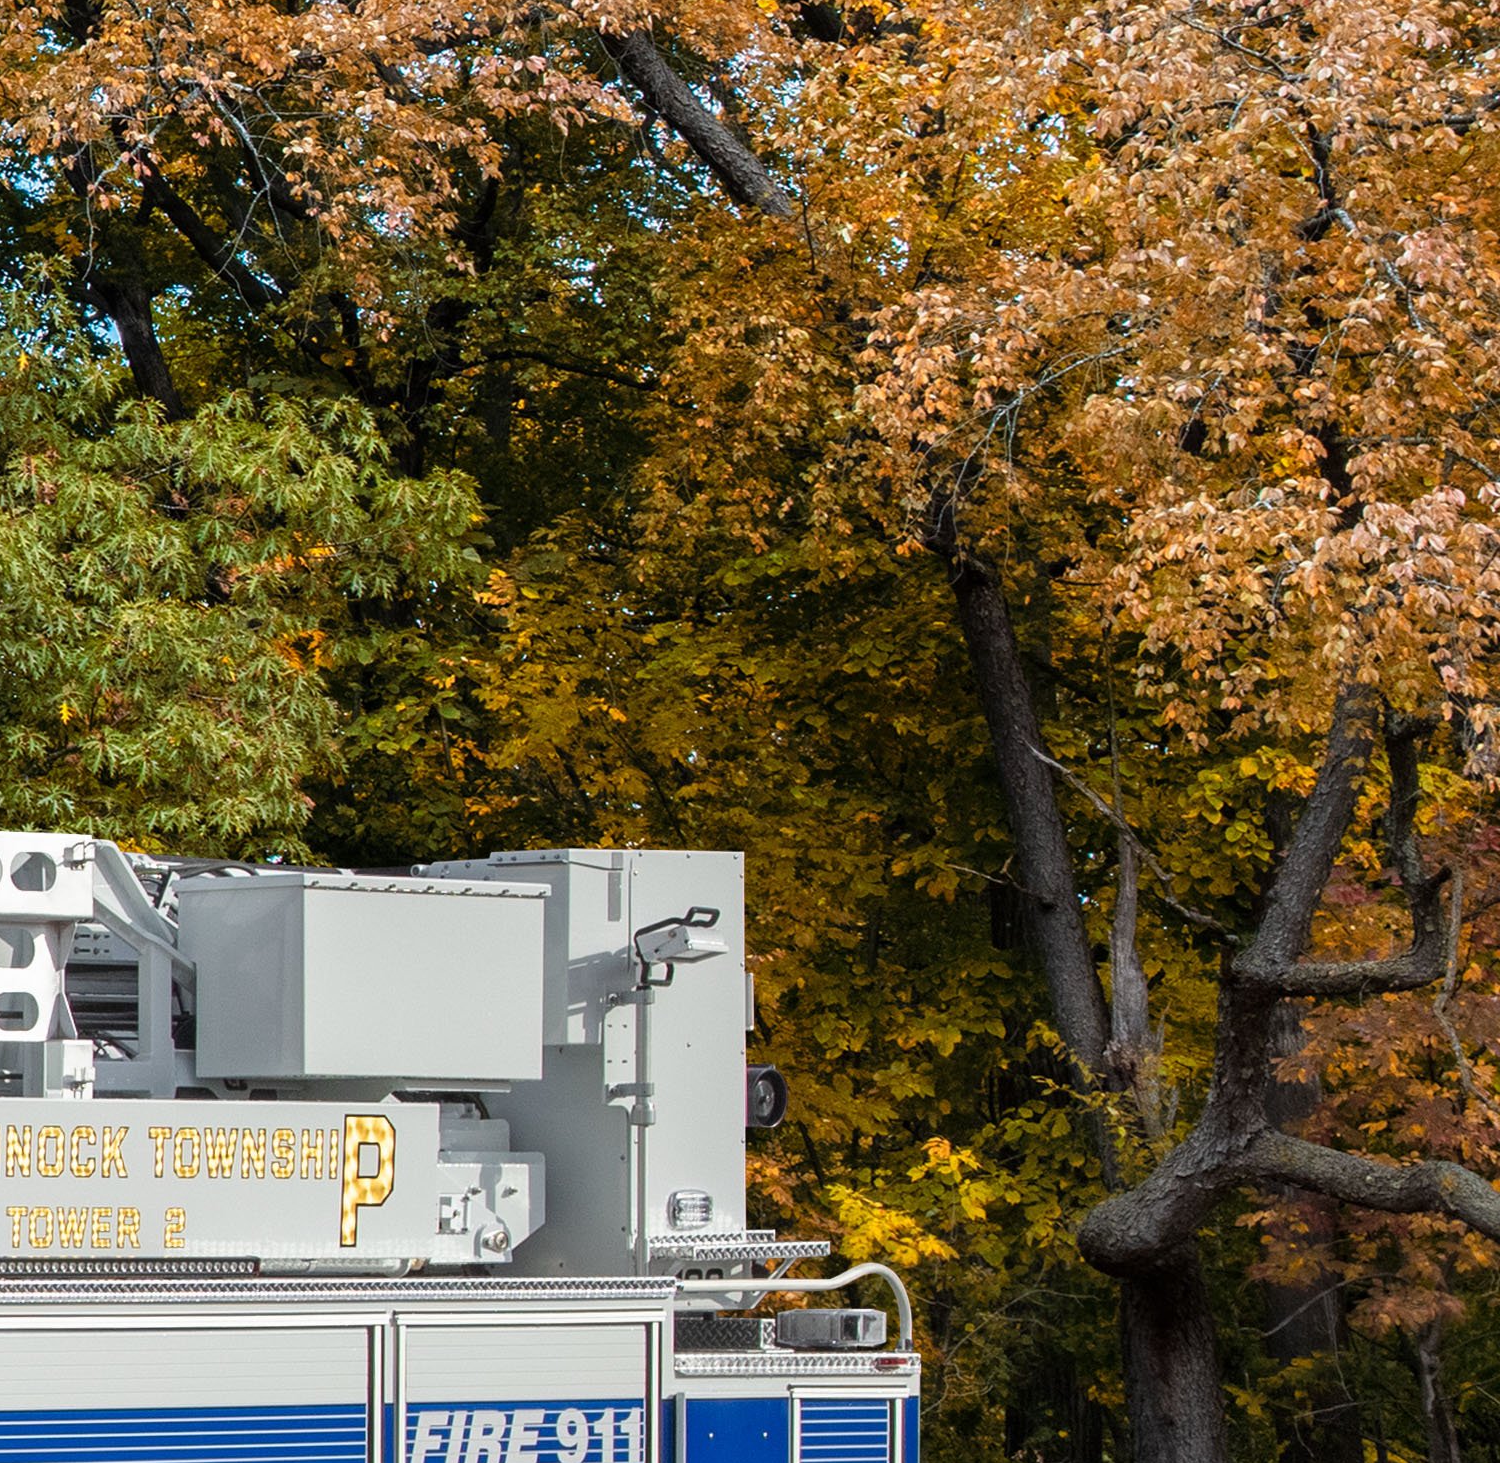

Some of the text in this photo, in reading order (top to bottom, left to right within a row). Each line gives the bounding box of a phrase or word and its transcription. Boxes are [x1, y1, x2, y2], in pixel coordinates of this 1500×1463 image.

[148, 1113, 396, 1248] TOWNSHIP
[5, 1205, 187, 1249] TOWER 2
